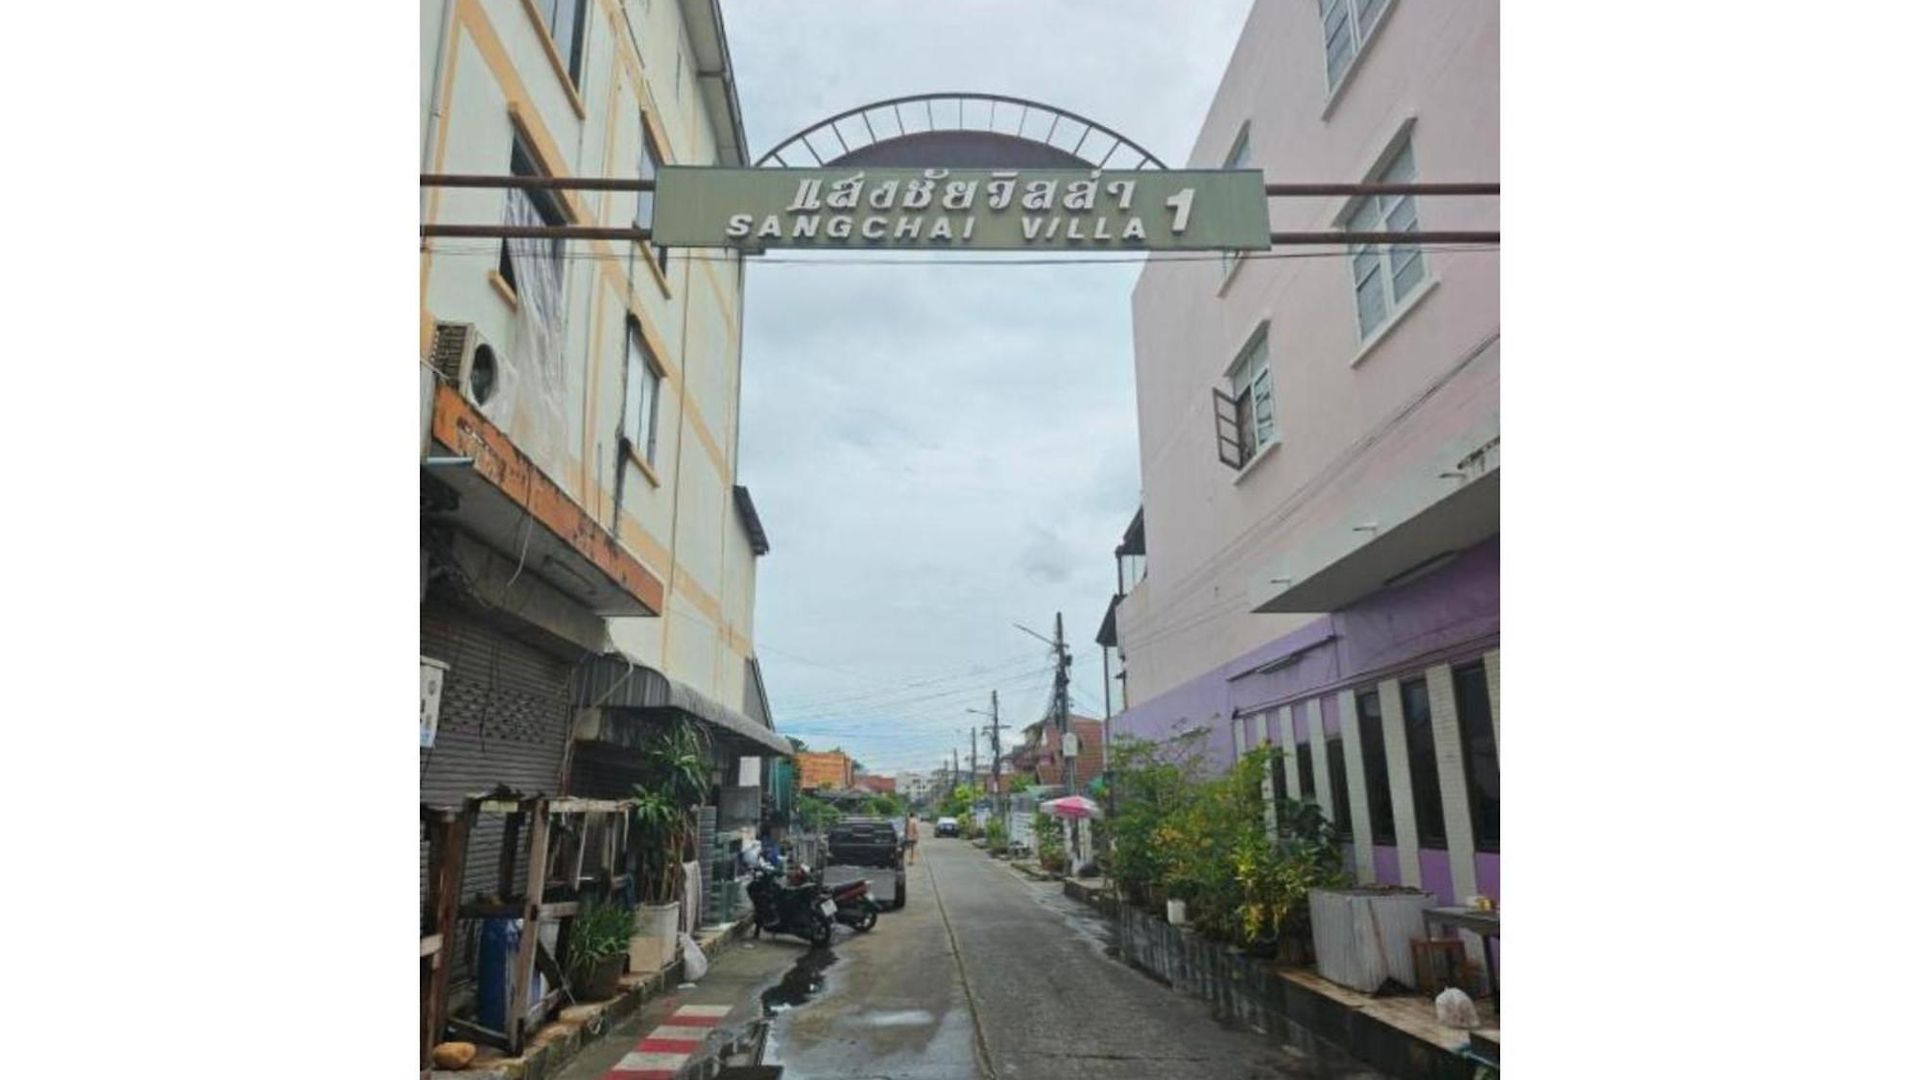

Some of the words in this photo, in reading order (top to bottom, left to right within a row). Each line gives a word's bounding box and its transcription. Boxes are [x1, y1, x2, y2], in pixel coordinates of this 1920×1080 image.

[725, 213, 976, 239] SANGCHAI
[1021, 216, 1147, 240] VILLA
[1164, 187, 1196, 233] 1
[786, 168, 1137, 213] แสงชัยวิลล่า
